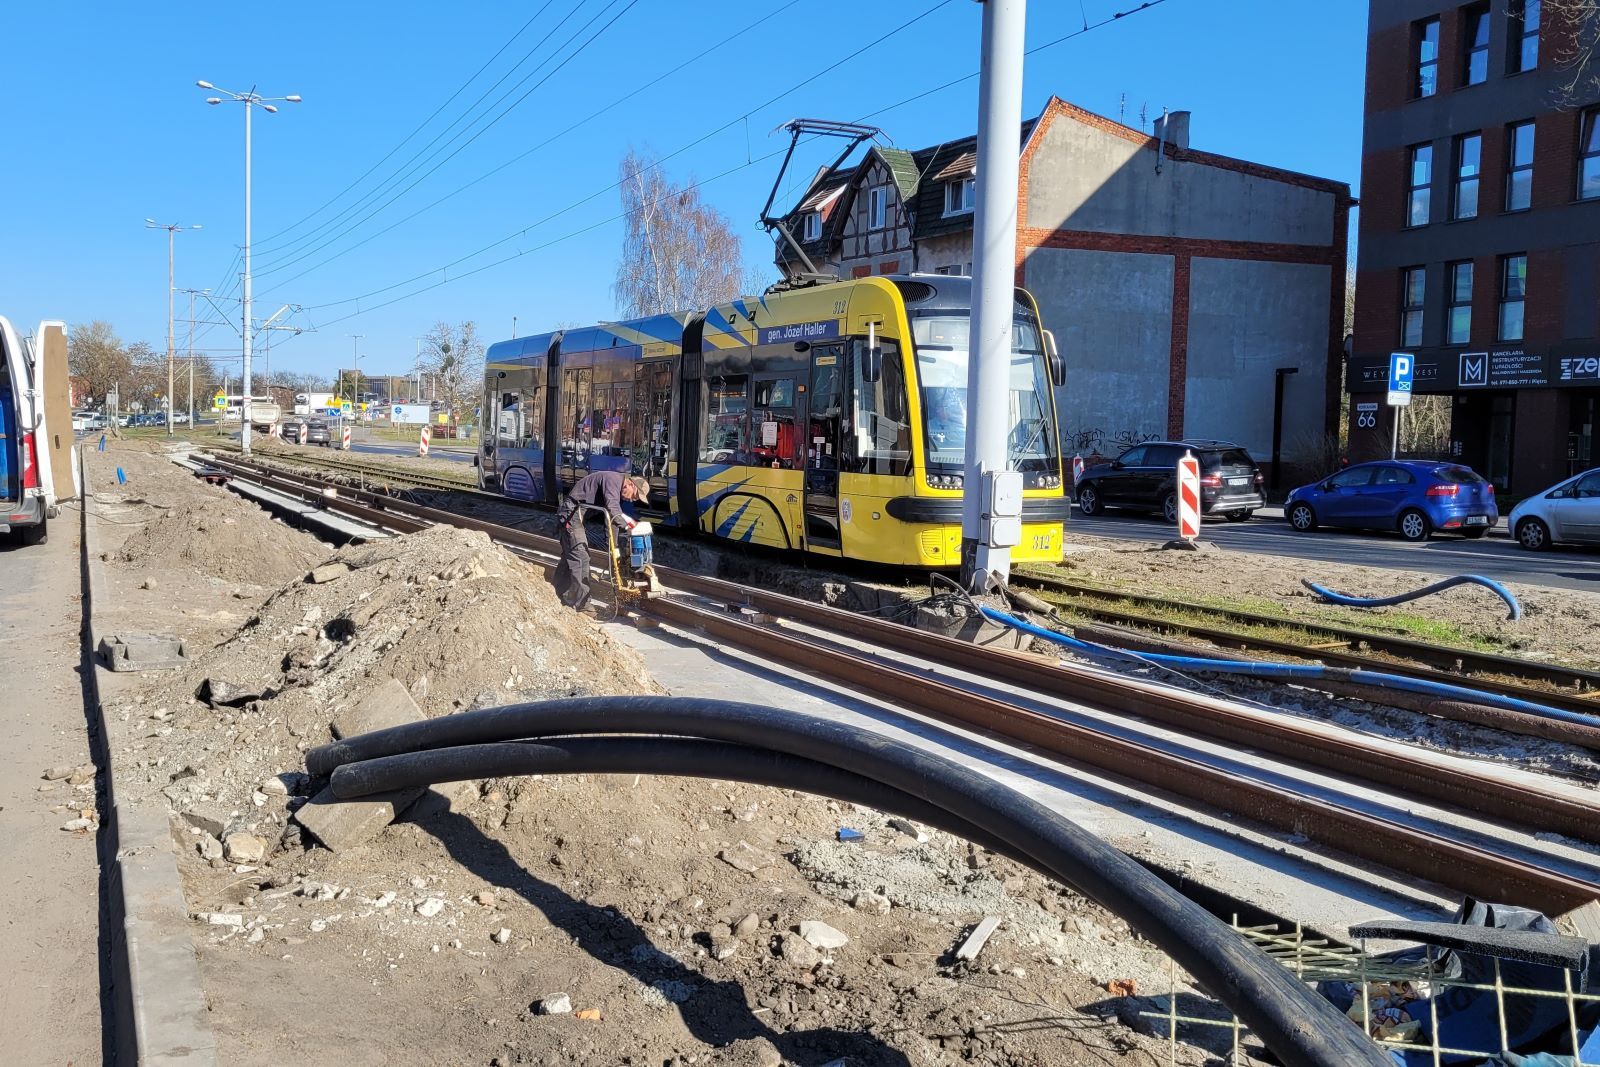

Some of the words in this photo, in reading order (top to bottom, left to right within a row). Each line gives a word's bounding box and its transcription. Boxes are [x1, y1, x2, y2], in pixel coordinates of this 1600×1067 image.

[833, 300, 847, 315] 312
[767, 330, 783, 343] gen.
[783, 324, 804, 339] Józef
[804, 322, 827, 336] Haller
[1395, 357, 1410, 381] P
[1358, 411, 1376, 428] 66
[1032, 535, 1050, 550] 312
